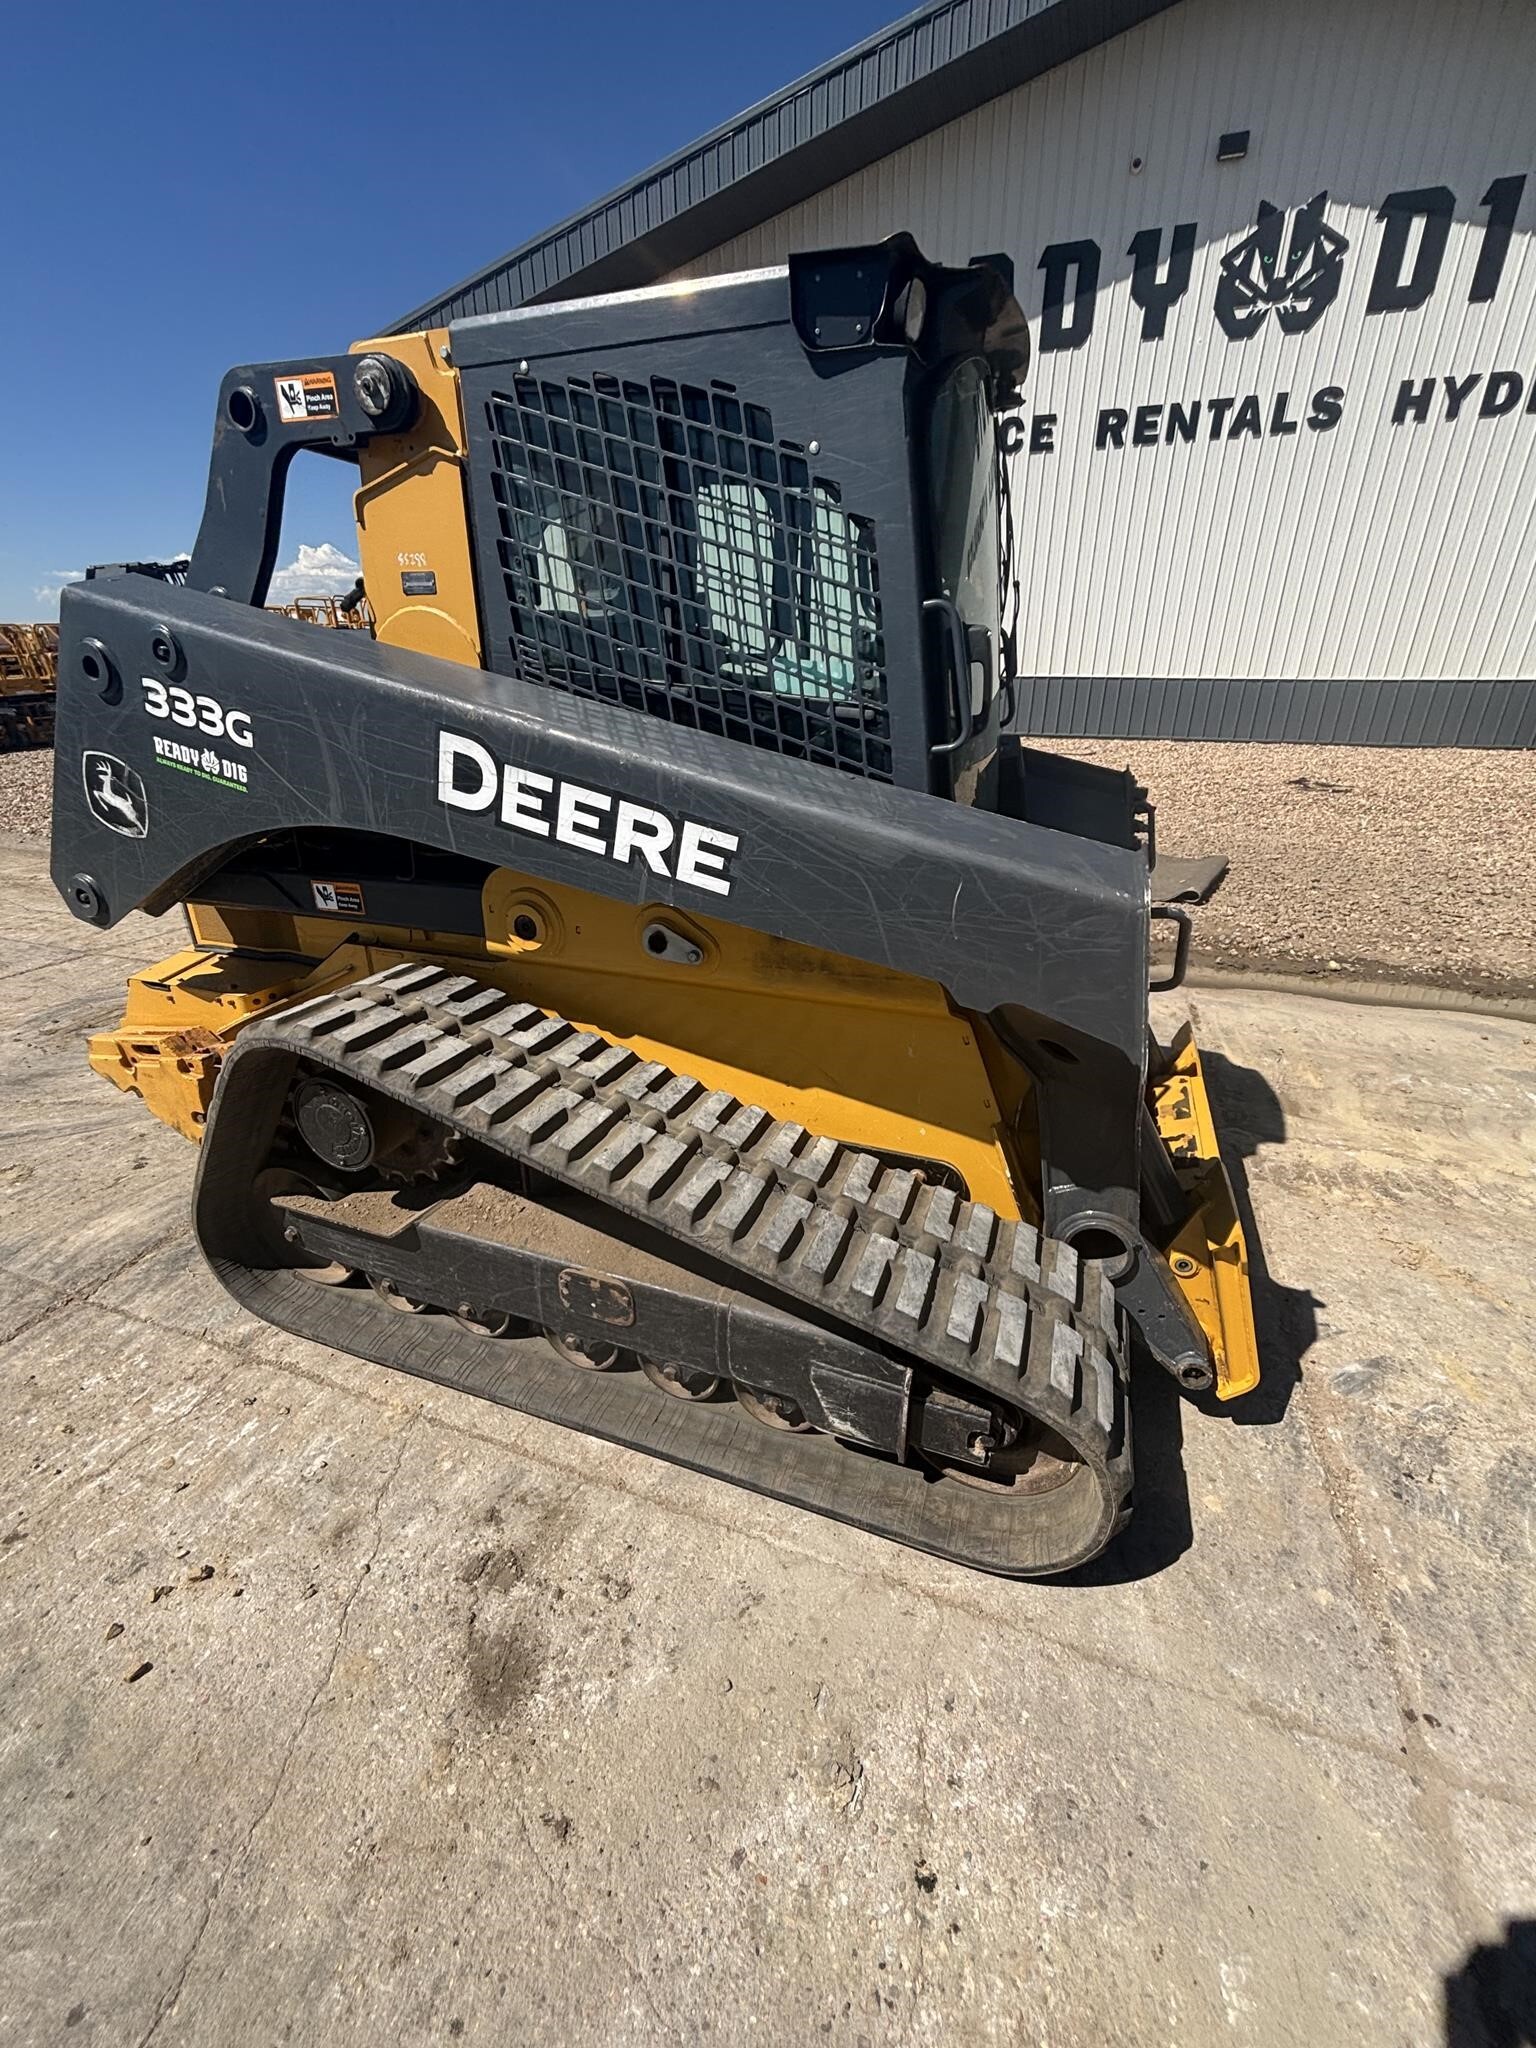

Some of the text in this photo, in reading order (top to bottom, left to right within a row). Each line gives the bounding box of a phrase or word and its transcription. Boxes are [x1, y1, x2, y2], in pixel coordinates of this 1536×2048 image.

[968, 222, 1198, 354] DY
[1095, 386, 1345, 450] RENTALS
[1391, 370, 1536, 425] HYD
[141, 677, 254, 748] 333G
[153, 736, 248, 783] READY DIG
[176, 763, 193, 774] READY
[194, 769, 201, 777] TO
[437, 730, 739, 896] DEERE
